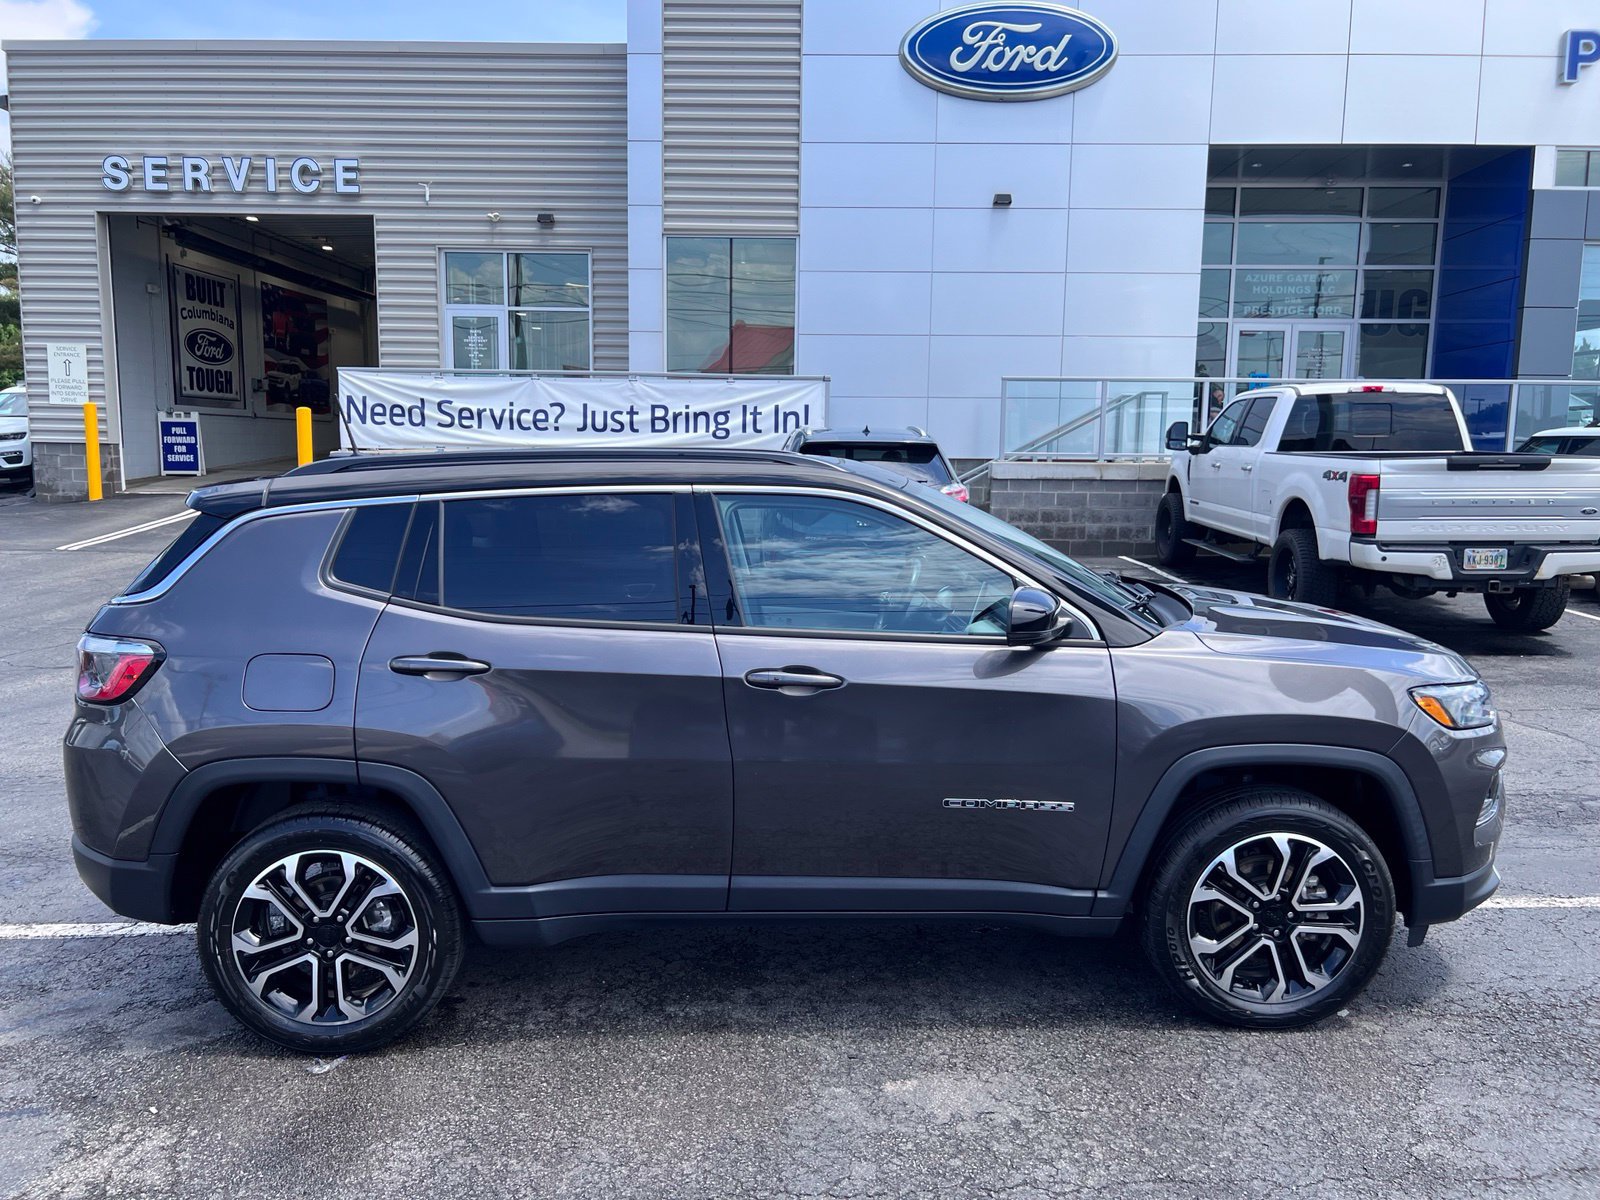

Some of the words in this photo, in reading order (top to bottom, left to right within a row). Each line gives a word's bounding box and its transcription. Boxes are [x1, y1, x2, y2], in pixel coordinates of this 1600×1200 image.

[950, 20, 1072, 72] Ford
[101, 154, 362, 194] SERVICE
[1245, 273, 1283, 282] AZURE
[184, 272, 226, 308] BUILT
[1252, 285, 1311, 294] HOLDINGS
[1315, 286, 1336, 295] LC
[180, 306, 235, 330] Columbiana
[1243, 305, 1304, 315] PRESTIGE
[1309, 305, 1342, 316] FORD
[194, 333, 224, 360] Ford
[186, 365, 233, 394] TOUGH
[346, 395, 426, 427] Need
[436, 400, 566, 432] Service?
[577, 403, 640, 433] Just
[650, 404, 730, 440] Bring
[741, 404, 763, 433] It
[167, 454, 194, 462] SERVICE
[942, 798, 1075, 812] COMPASS
